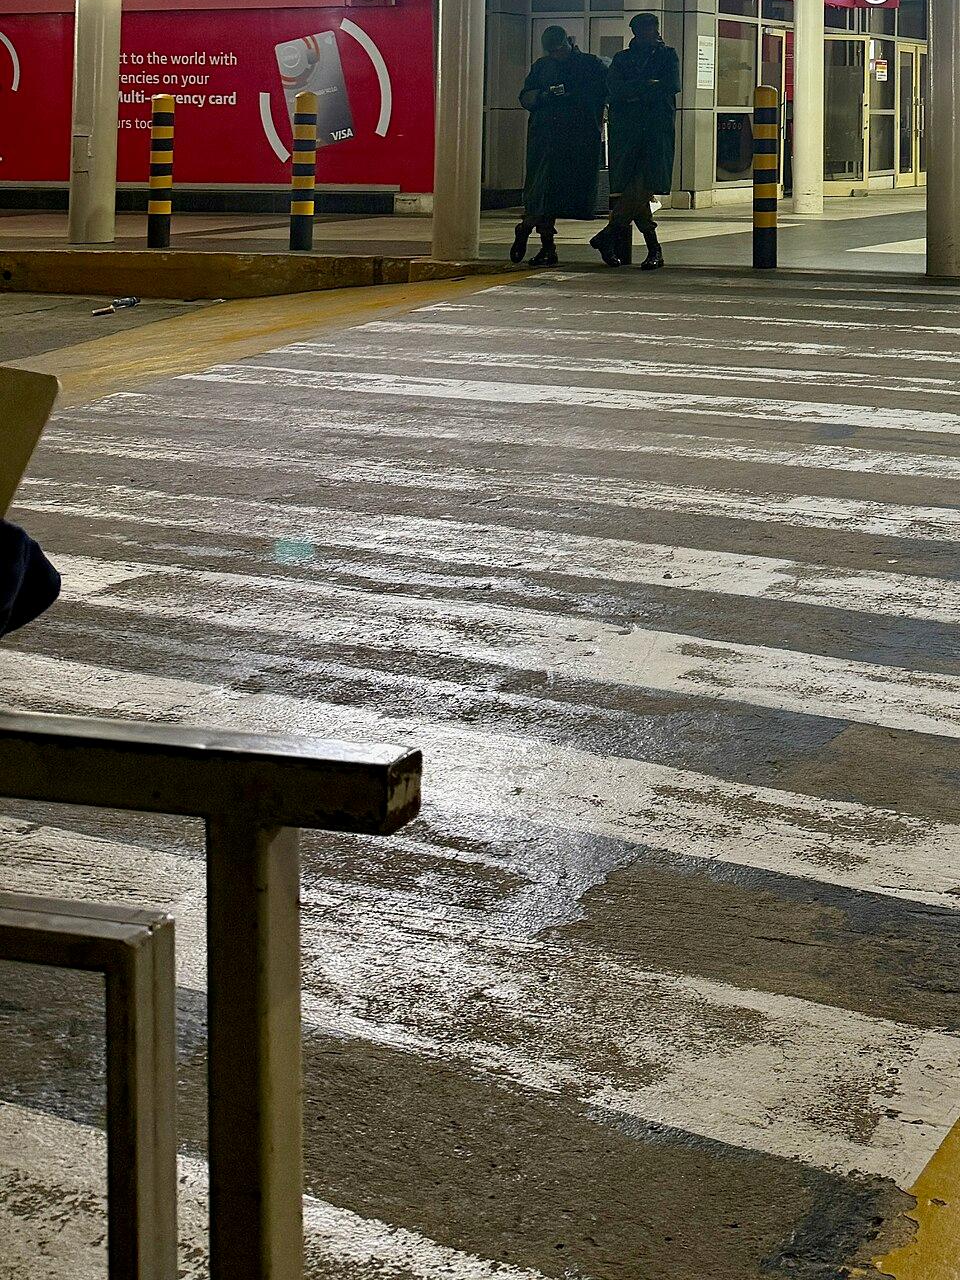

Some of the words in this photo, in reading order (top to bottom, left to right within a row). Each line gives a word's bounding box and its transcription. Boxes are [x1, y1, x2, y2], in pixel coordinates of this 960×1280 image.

[130, 52, 144, 65] to
[147, 51, 168, 65] the
[170, 51, 206, 65] world
[209, 52, 237, 65] with
[162, 74, 178, 84] on
[181, 74, 210, 88] your
[208, 91, 237, 105] card
[330, 128, 354, 141] VISA
